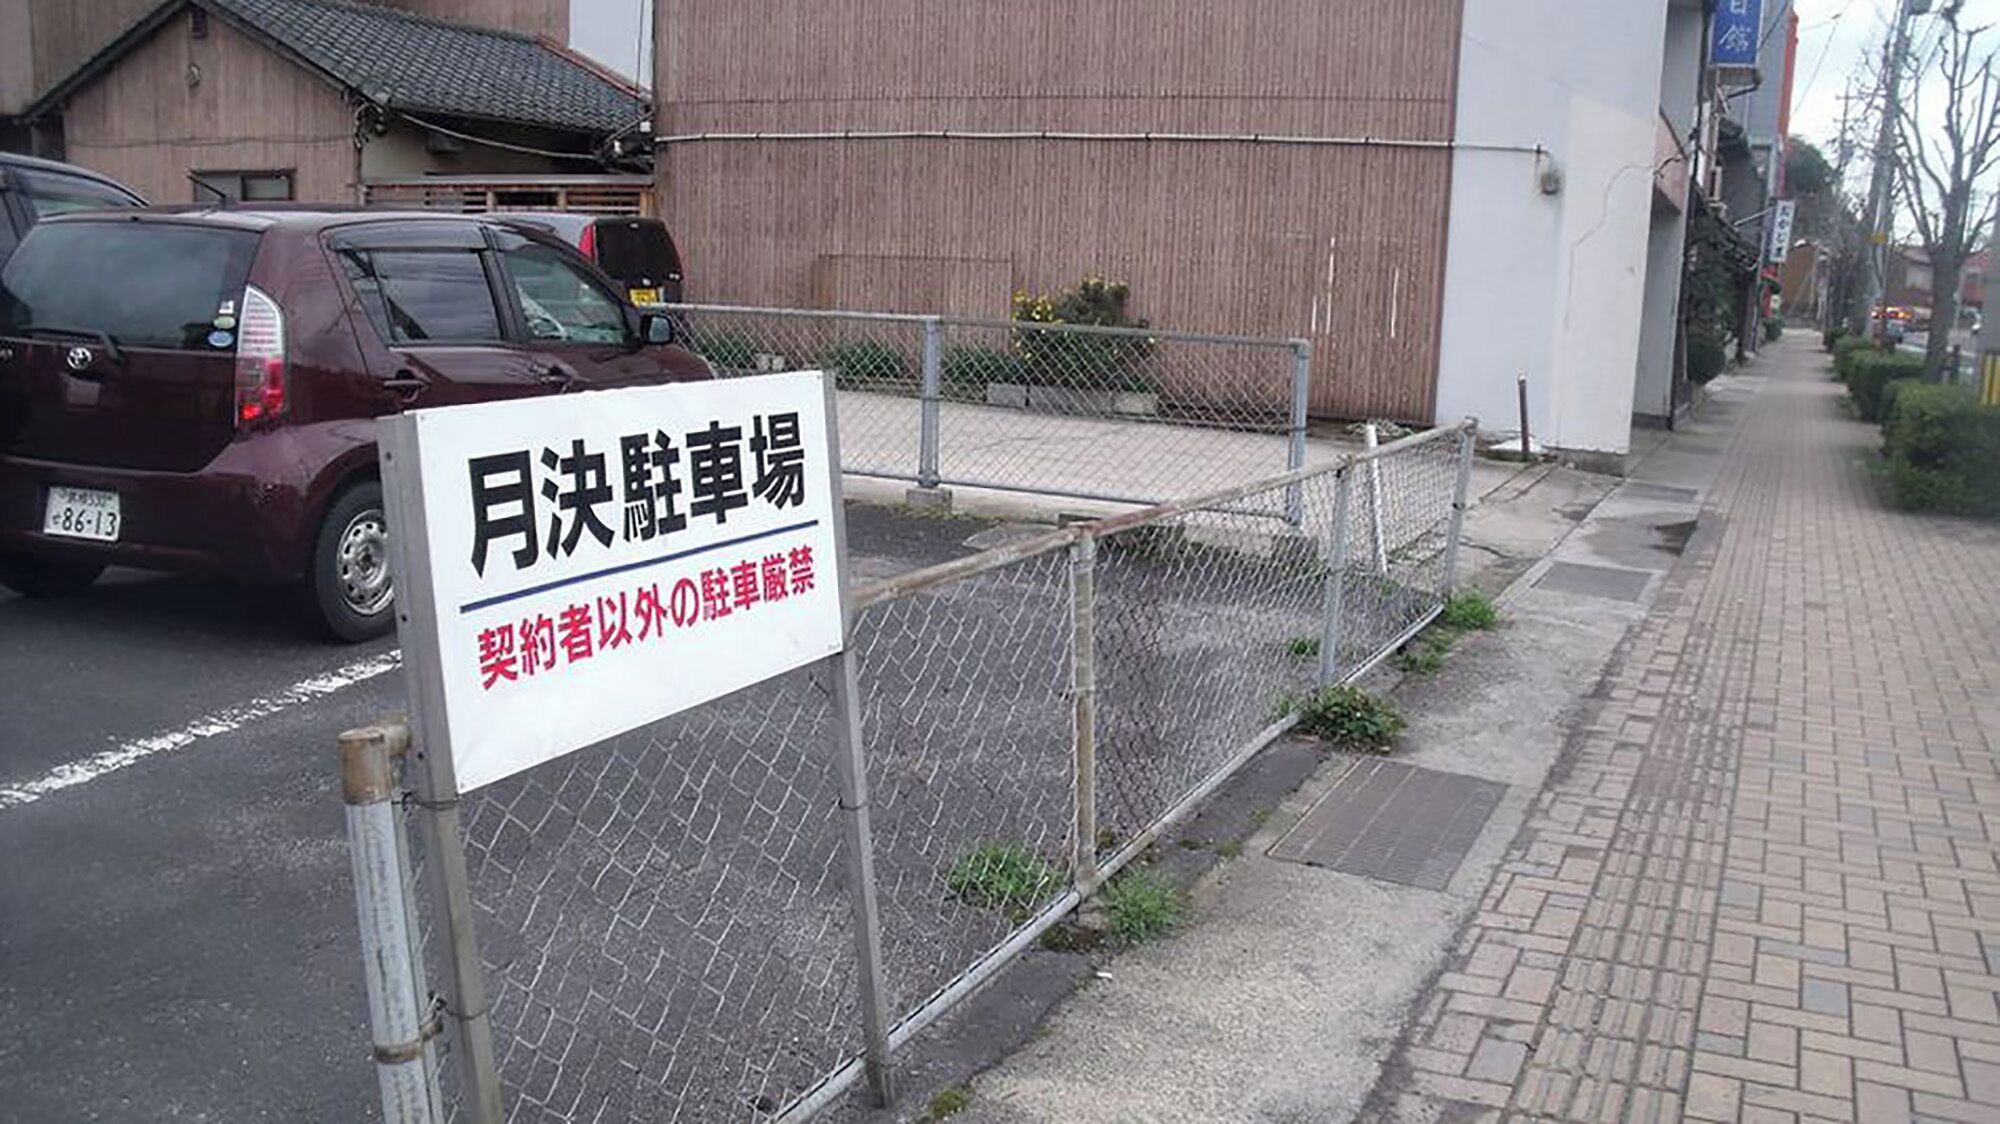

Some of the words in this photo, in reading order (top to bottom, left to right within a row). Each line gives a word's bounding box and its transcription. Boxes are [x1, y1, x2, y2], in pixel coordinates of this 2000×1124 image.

[468, 411, 807, 578] 月決駐車場
[477, 544, 815, 689] 契約者以外の駐車厳禁
